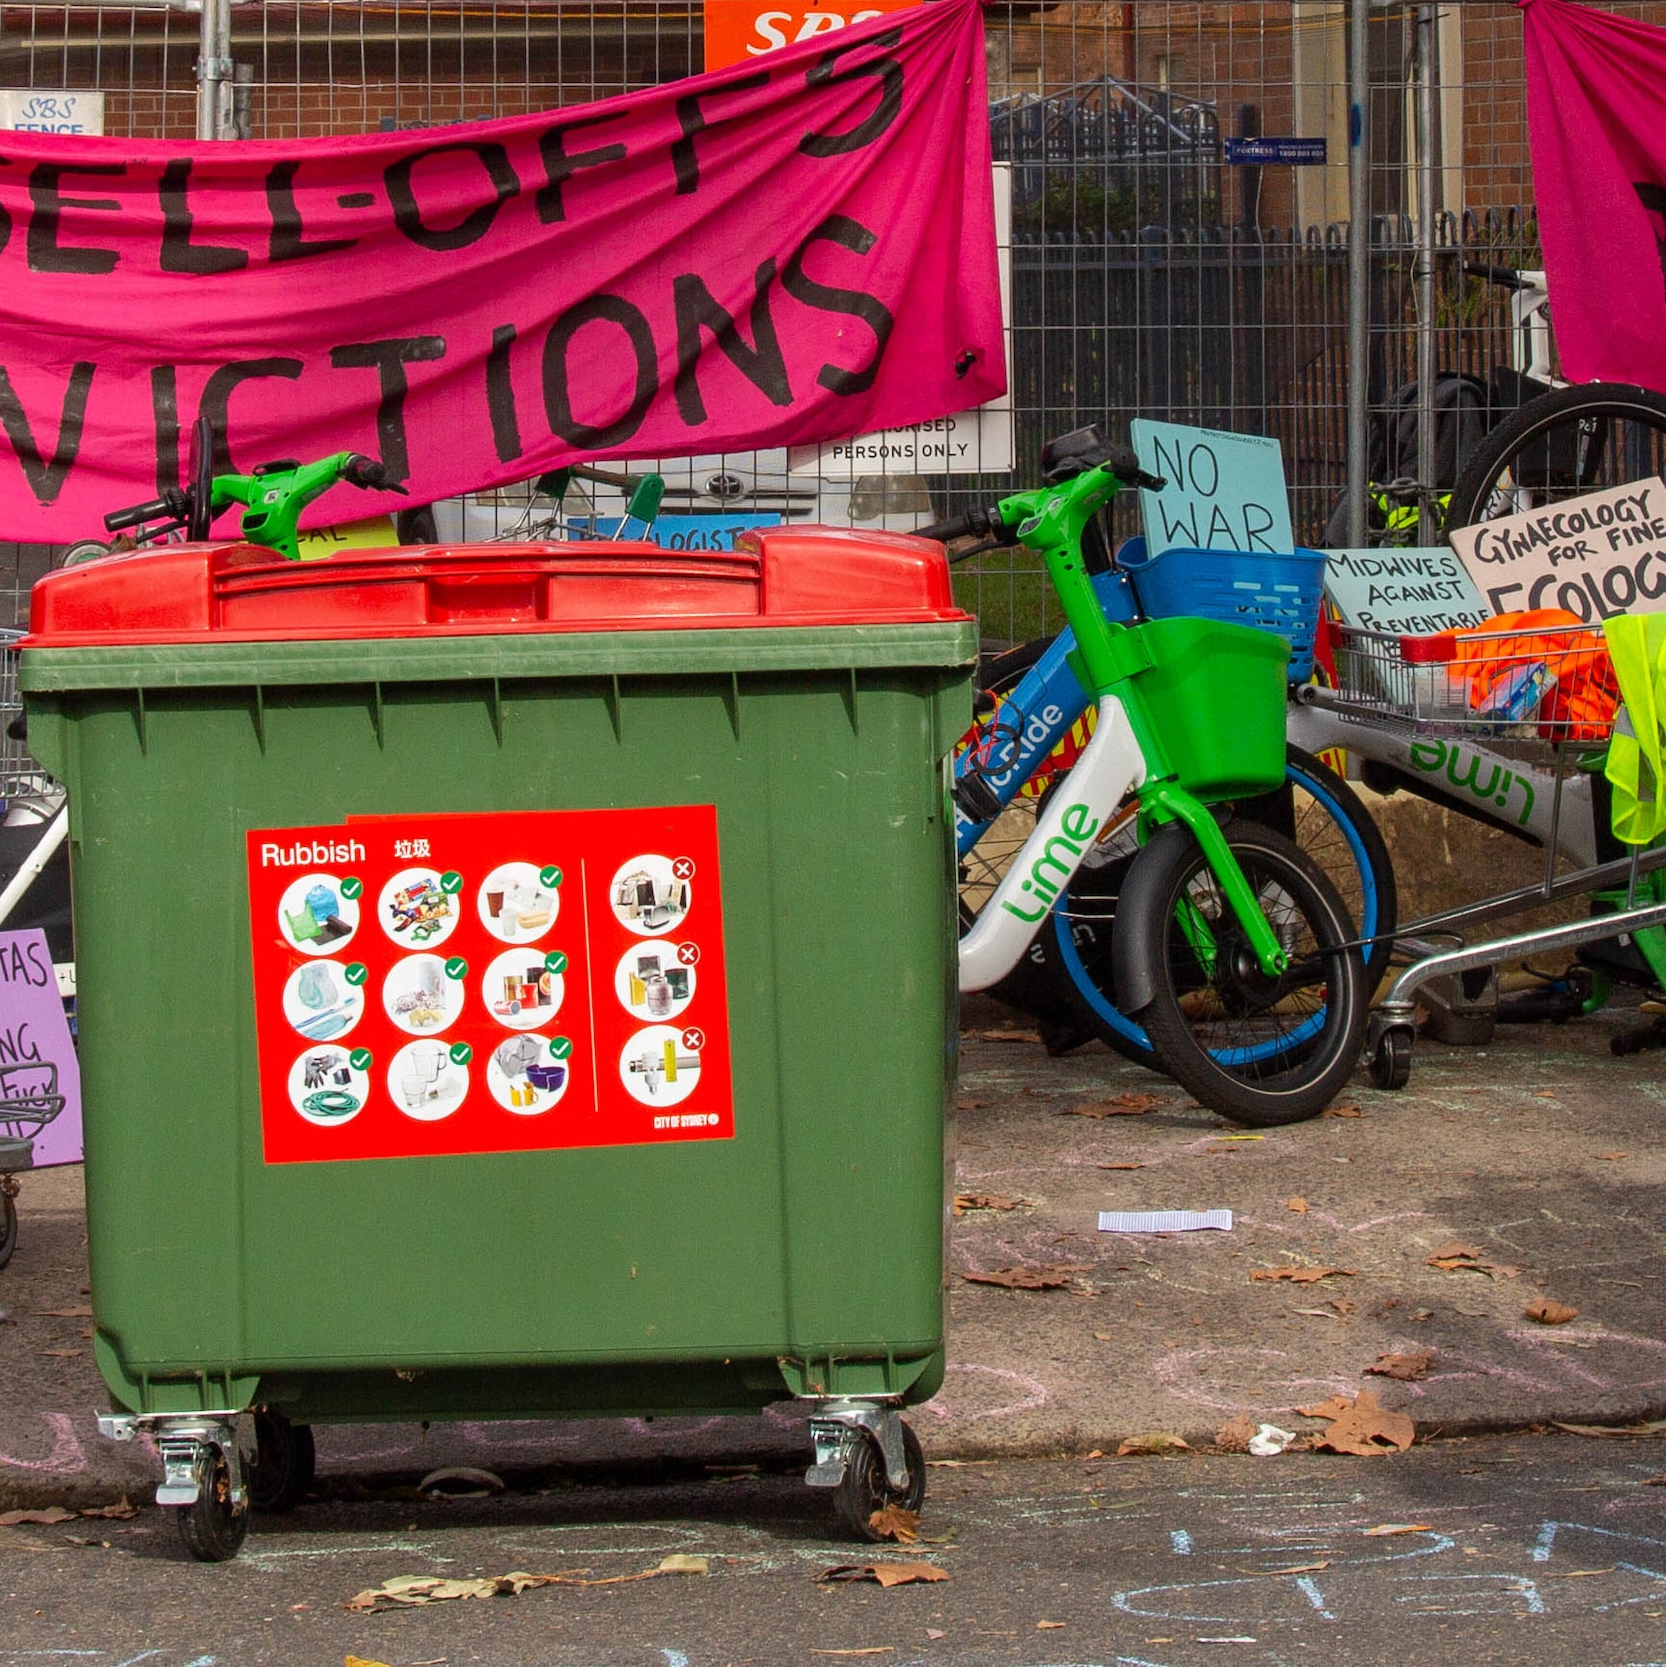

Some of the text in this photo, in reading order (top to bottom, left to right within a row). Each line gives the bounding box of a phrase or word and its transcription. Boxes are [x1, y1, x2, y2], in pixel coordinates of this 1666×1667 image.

[22, 97, 76, 119] SBS
[833, 443, 968, 459] PERSONS ONLY
[1154, 436, 1218, 497] NO
[1158, 499, 1277, 554] WAR
[1475, 489, 1650, 565] GYNAECOLOGY
[1328, 553, 1458, 579] MIDWIVES
[1548, 540, 1598, 567] FOR
[1368, 580, 1466, 607] AGAINST
[1357, 609, 1490, 634] PREVENTABLE
[1411, 739, 1535, 825] Lime
[261, 839, 366, 867] Rubbish
[394, 839, 432, 859] 垃圾
[1002, 803, 1099, 923] Lime
